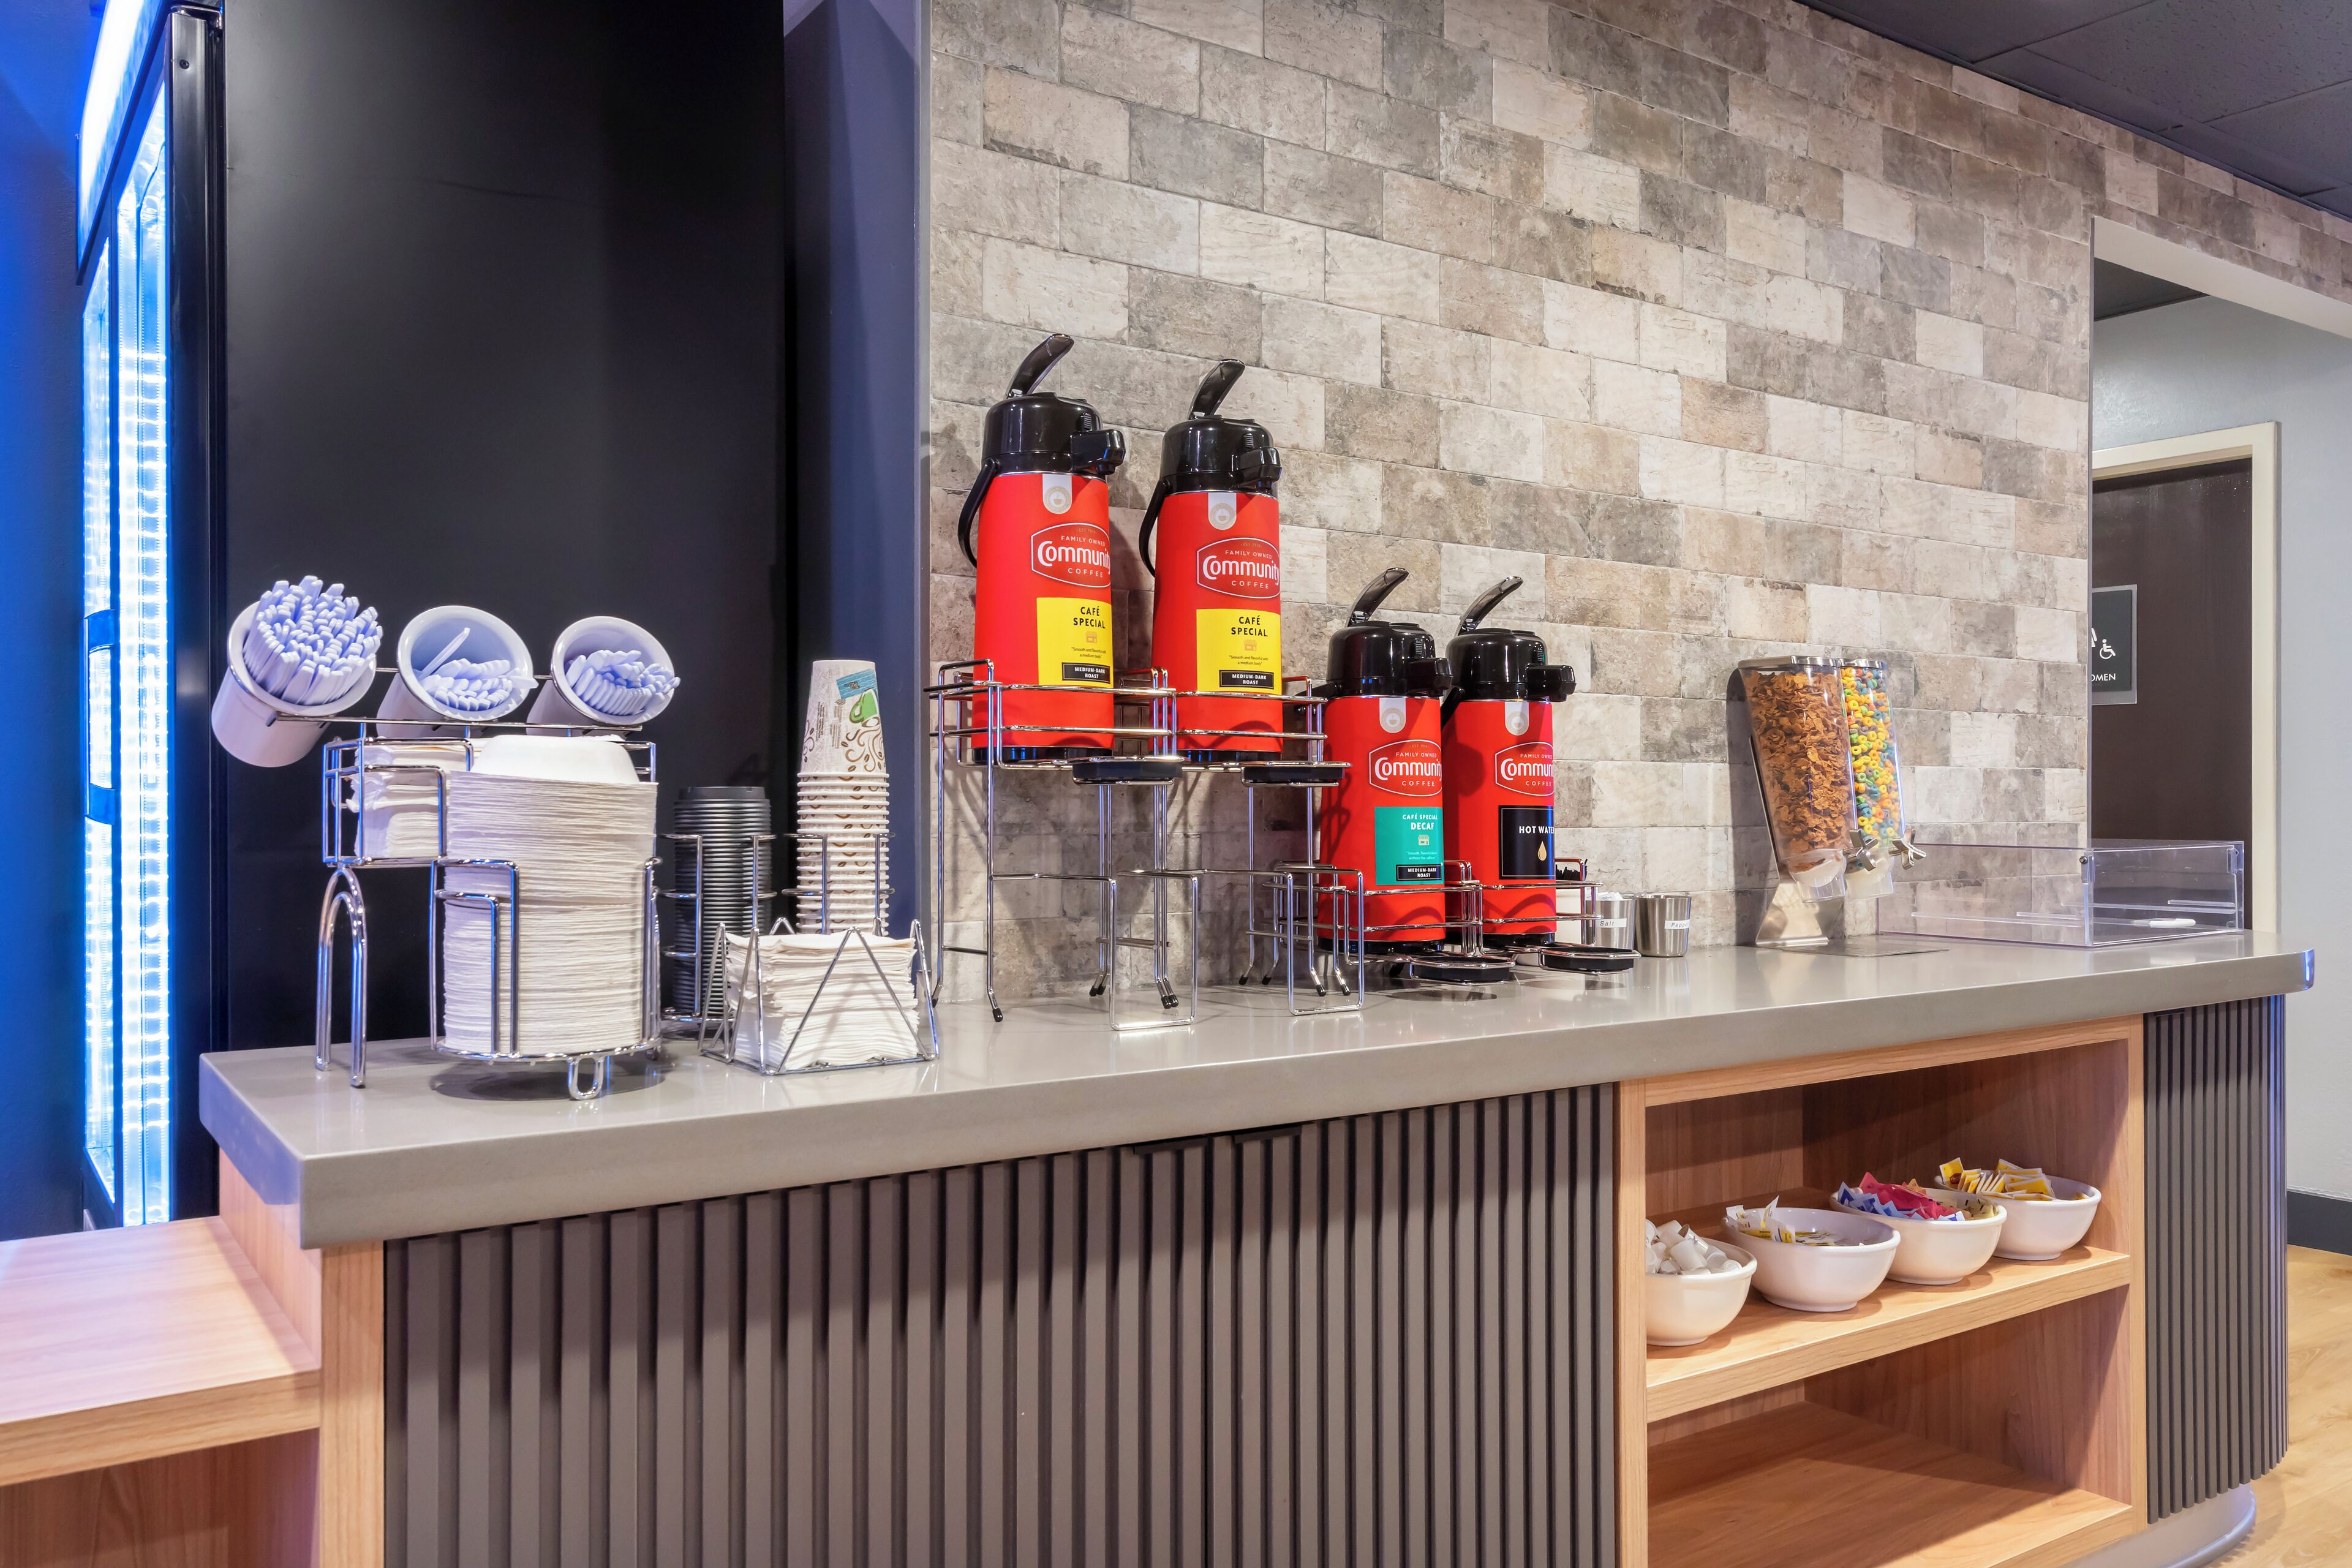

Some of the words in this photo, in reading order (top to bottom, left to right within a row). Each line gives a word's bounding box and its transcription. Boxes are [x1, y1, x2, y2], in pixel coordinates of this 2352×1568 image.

[1088, 538, 1106, 547] OWNED
[1068, 568, 1103, 578] COFFEE
[1202, 555, 1280, 586] Community
[1080, 606, 1100, 616] CAFÉ
[1073, 617, 1106, 628] SPECIAL
[1238, 615, 1261, 625] CAFÉ
[1231, 627, 1267, 636] SPECIAL
[2091, 673, 2116, 682] OMEN
